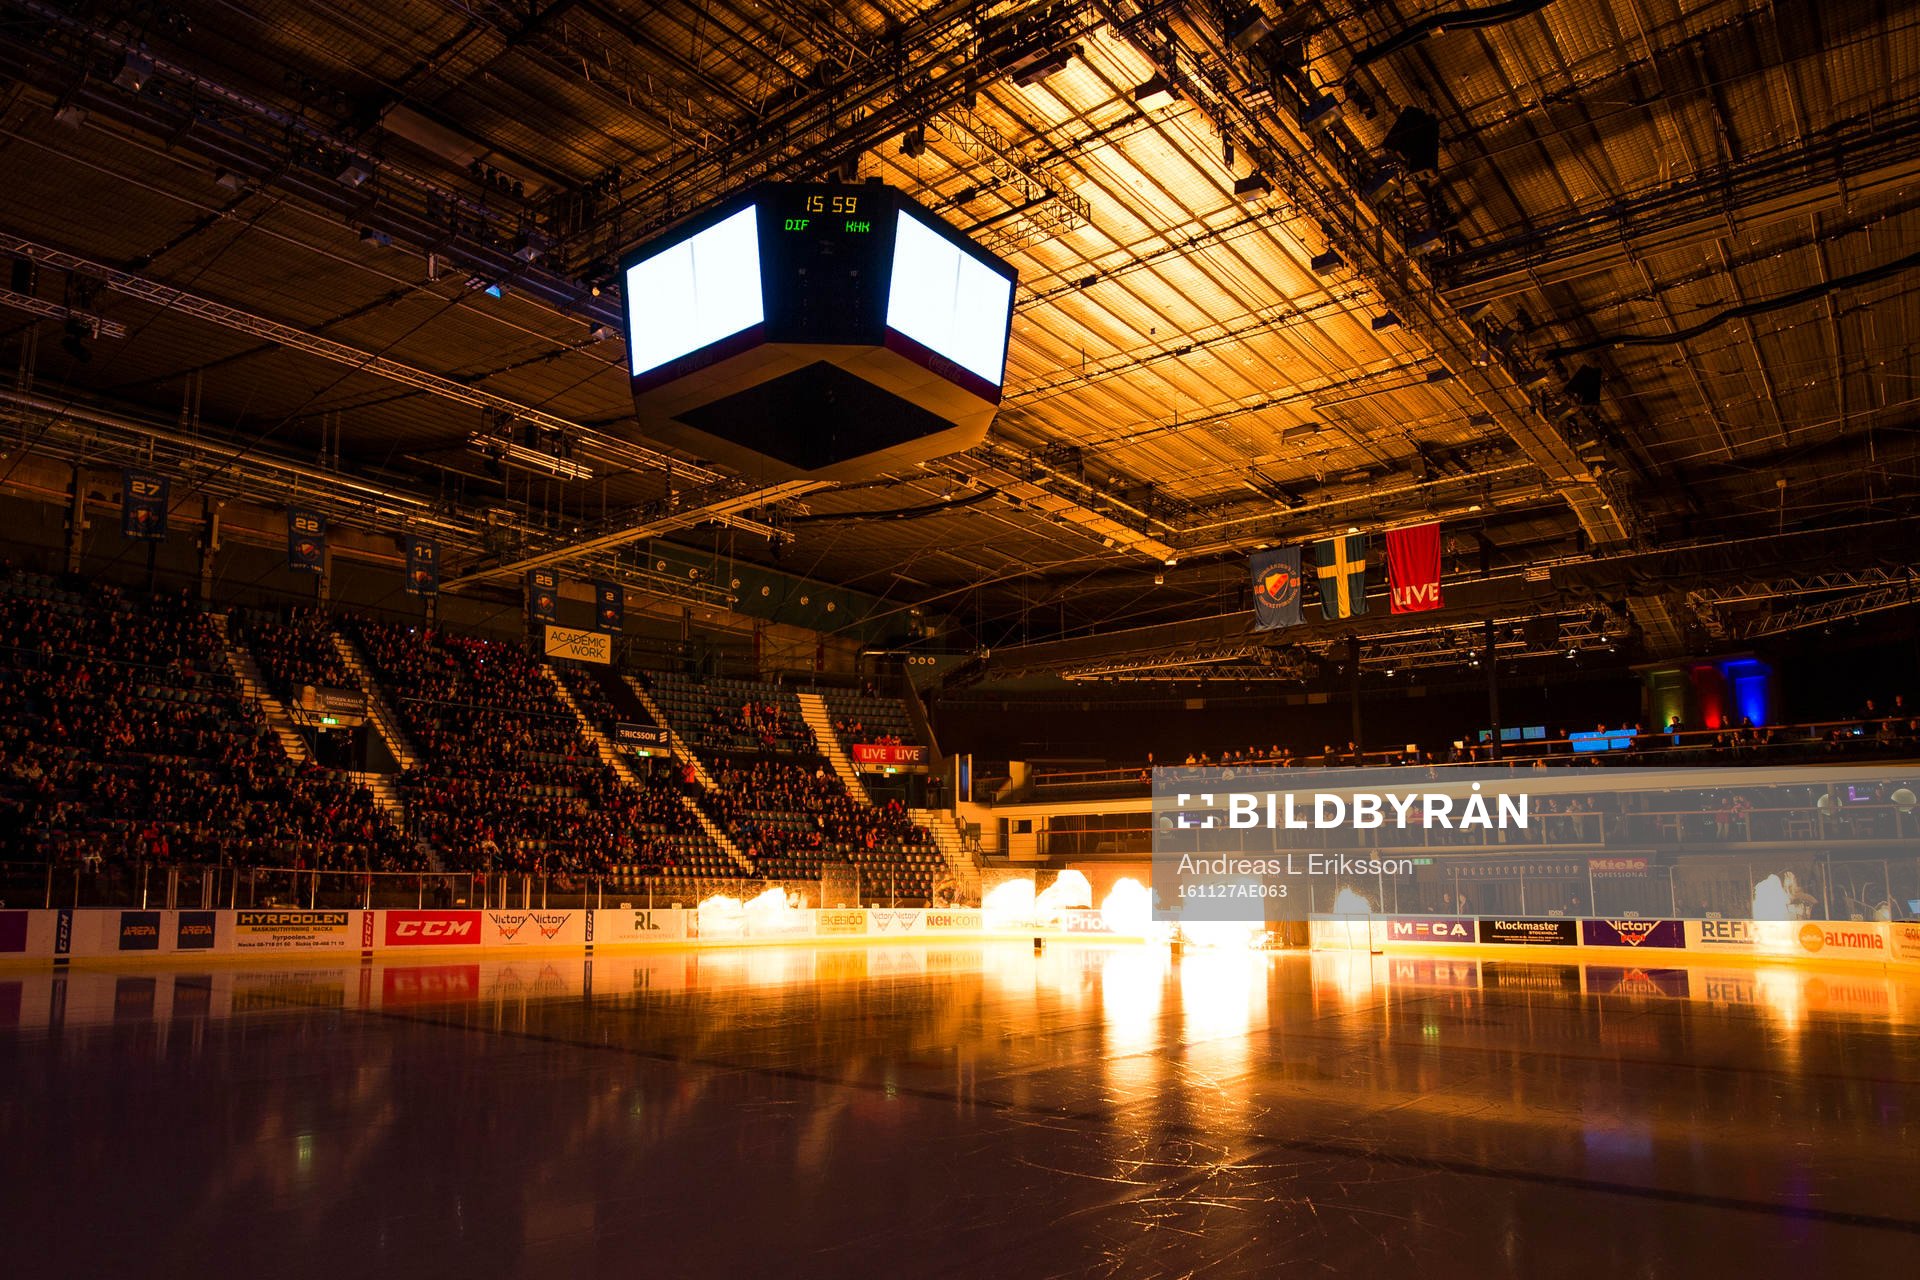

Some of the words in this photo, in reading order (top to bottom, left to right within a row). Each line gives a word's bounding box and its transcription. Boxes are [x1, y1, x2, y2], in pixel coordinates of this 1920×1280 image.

[806, 196, 824, 212] 15
[832, 196, 857, 213] 59
[785, 219, 809, 231] DIF
[132, 481, 160, 495] 27
[296, 517, 319, 532] 22
[535, 574, 553, 587] 25
[605, 592, 614, 601] 2
[1393, 582, 1439, 606] LIVE
[550, 631, 607, 649] ACADEMIC
[862, 748, 887, 760] LIVE
[895, 749, 919, 761] LIVE
[1589, 860, 1645, 870] Miele
[241, 914, 345, 924] HYRPOOLEN
[1495, 920, 1559, 931] Klockmaster
[395, 921, 472, 936] CCM
